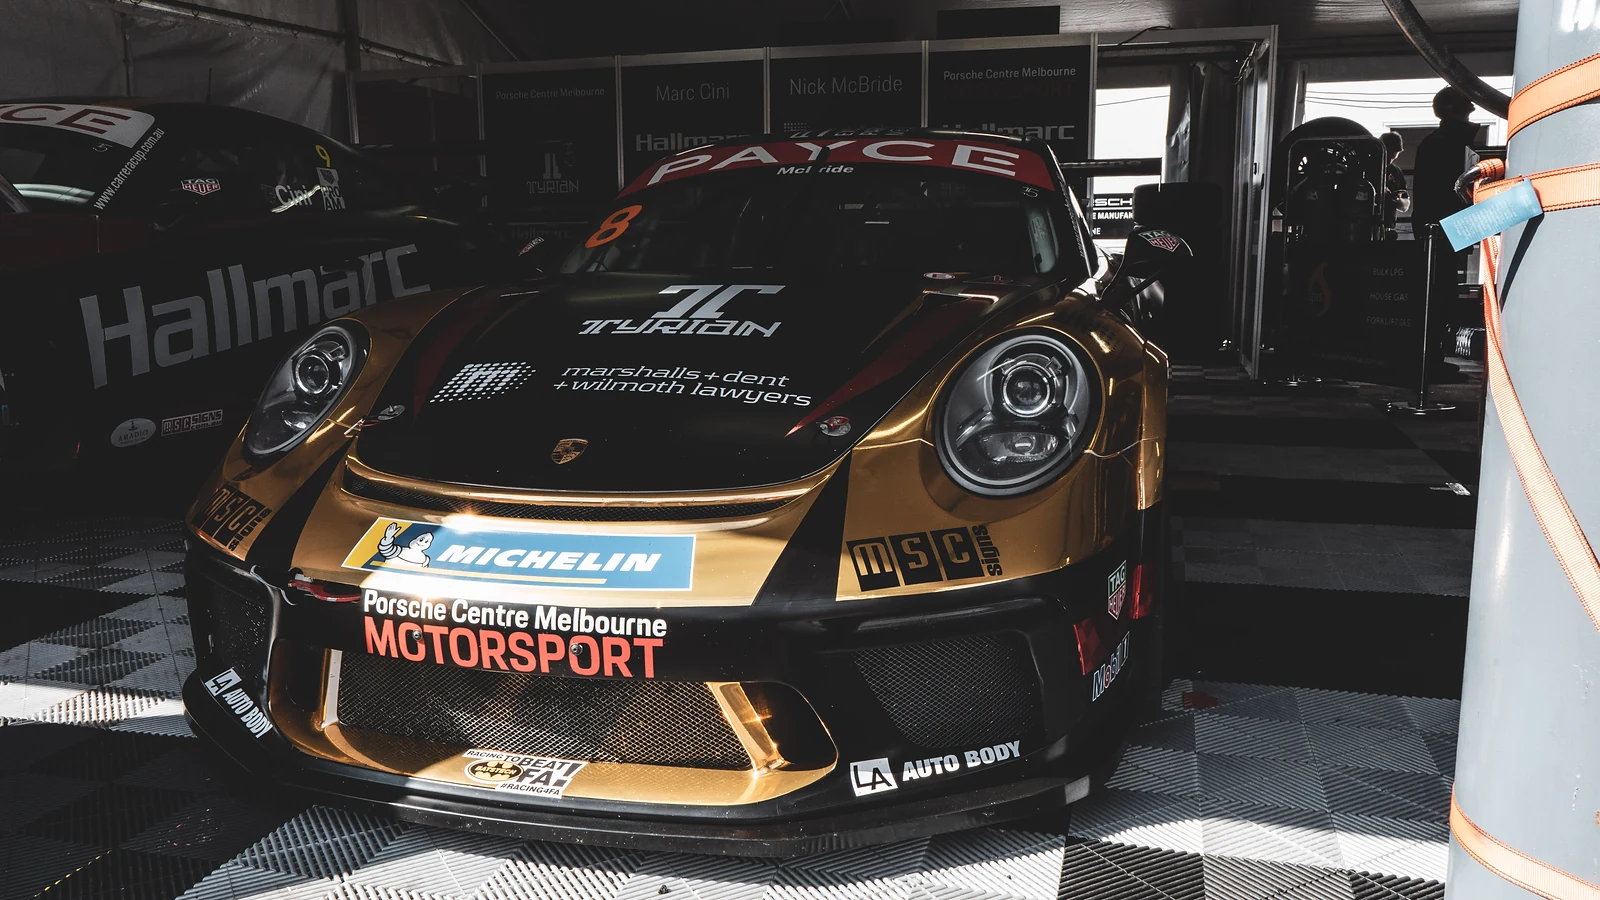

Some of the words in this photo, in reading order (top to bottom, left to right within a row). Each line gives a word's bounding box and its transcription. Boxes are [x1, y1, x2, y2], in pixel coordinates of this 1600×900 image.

[790, 77, 827, 96] Nick
[832, 75, 903, 94] McBride
[943, 70, 983, 81] Porsche
[985, 69, 1020, 79] Centre
[1022, 66, 1077, 78] Melbourne
[496, 90, 529, 100] Porsche
[530, 89, 558, 99] Centre
[560, 87, 605, 98] Melbourne
[656, 85, 695, 102] Marc
[700, 83, 730, 100] Cini
[0, 104, 131, 134] CE
[315, 144, 331, 168] 9
[647, 140, 1021, 186] PAYCE
[93, 127, 166, 211] www.carreracup.com.au
[275, 184, 313, 207] Cini
[321, 186, 341, 198] PRO
[325, 197, 344, 210] AM
[585, 205, 643, 248] 8
[1390, 268, 1404, 277] LPG
[1370, 292, 1392, 301] HOUSE
[80, 243, 431, 390] Hallmarc
[690, 382, 812, 407] lawyers
[118, 430, 148, 442] AMADIO
[436, 544, 662, 572] MICHELIN
[1109, 564, 1126, 593] TAG
[363, 588, 446, 621] Porsche
[451, 598, 528, 629] Centre
[534, 605, 667, 638] Melbourne
[364, 615, 664, 679] MOTORSPORT
[222, 687, 254, 715] AUTO
[240, 706, 273, 739] BODY
[467, 750, 503, 760] RACING
[503, 754, 520, 763] TO
[519, 757, 570, 771] BEAT
[902, 754, 960, 782] AUTO
[964, 740, 1020, 768] BODY
[500, 782, 560, 796] #RACING4FA
